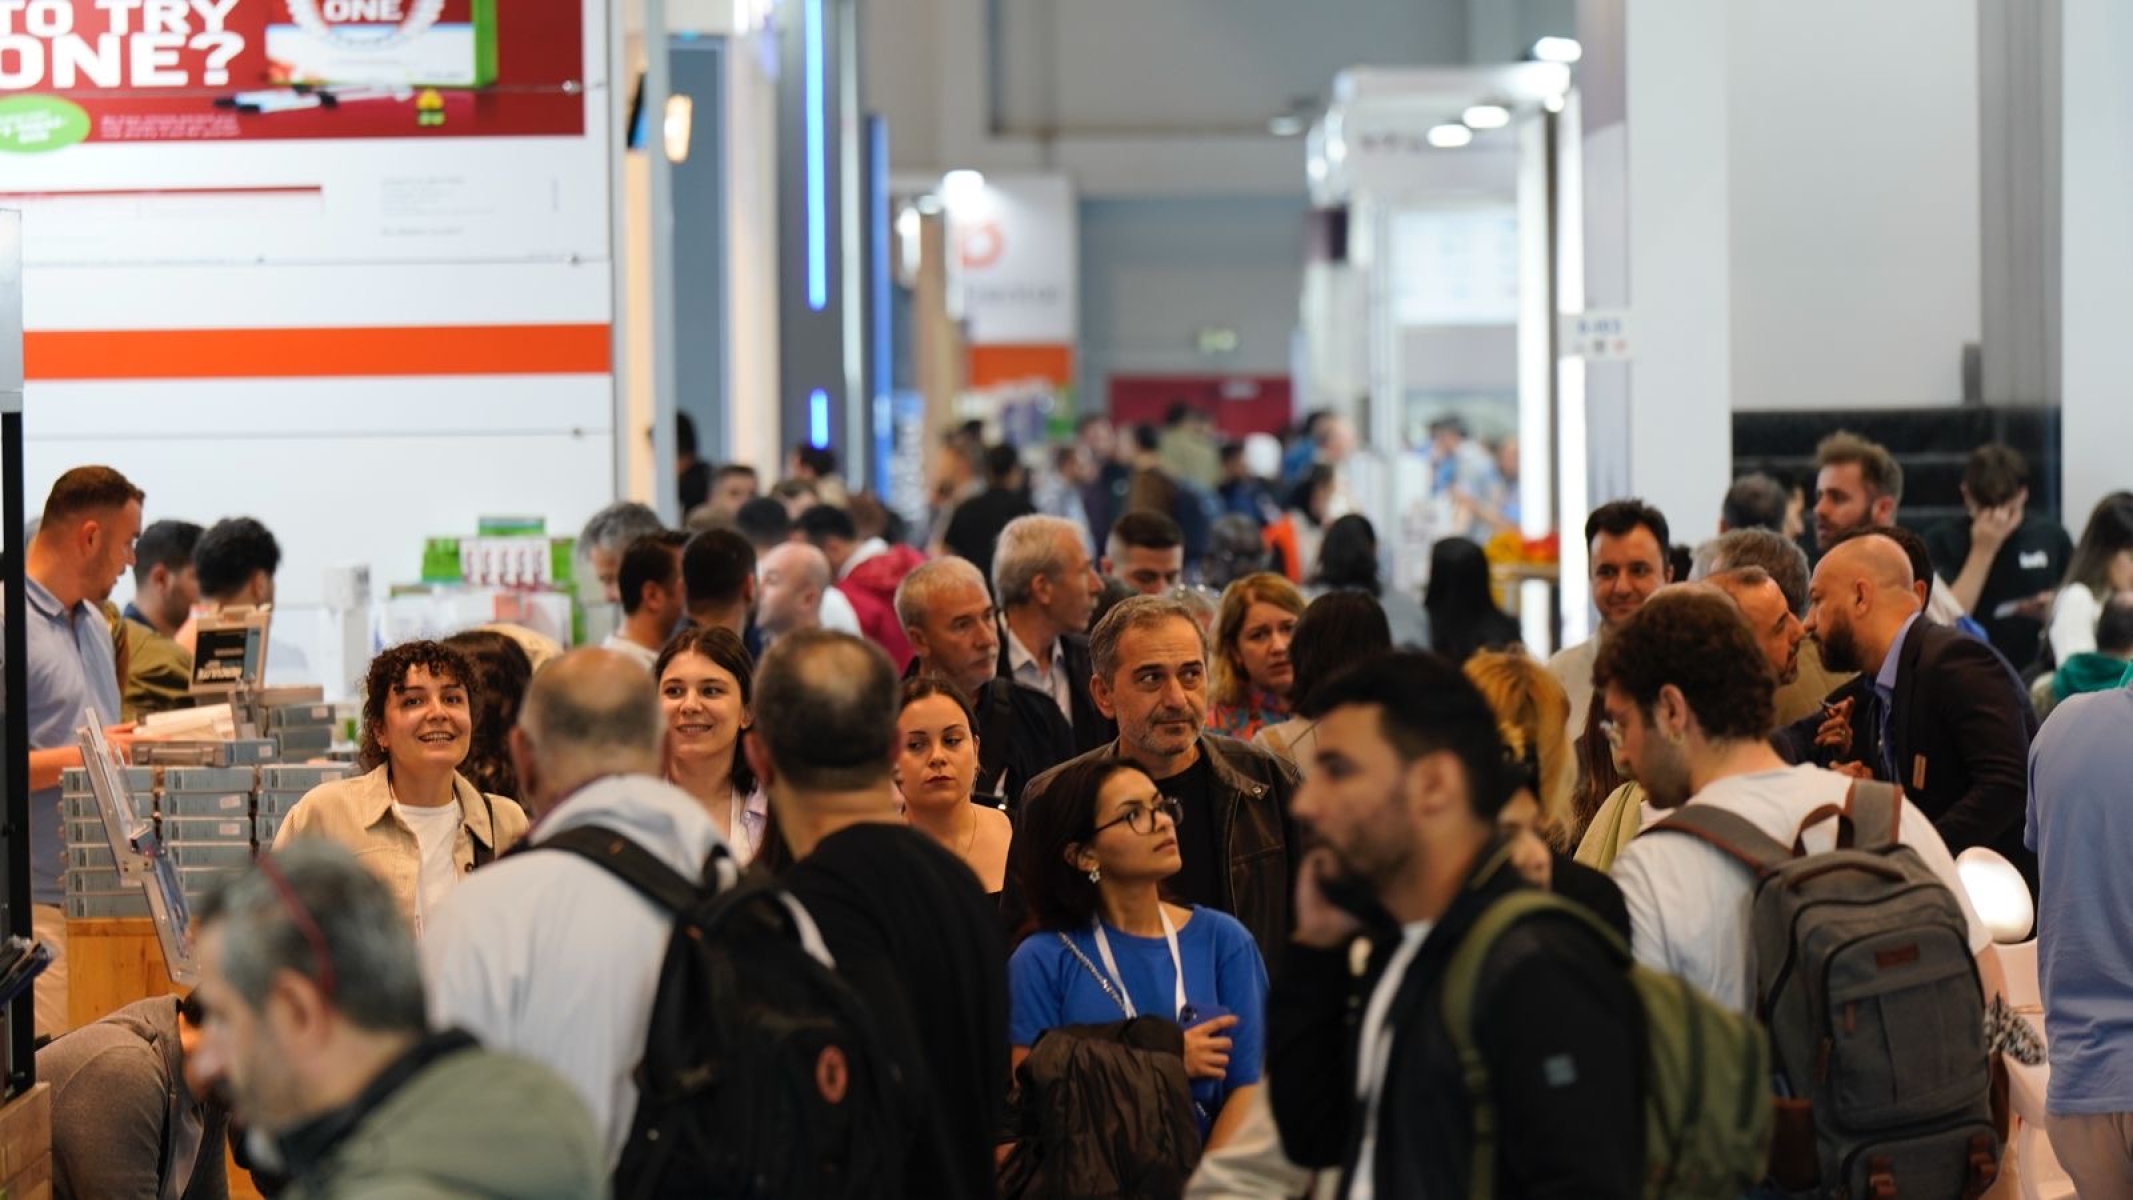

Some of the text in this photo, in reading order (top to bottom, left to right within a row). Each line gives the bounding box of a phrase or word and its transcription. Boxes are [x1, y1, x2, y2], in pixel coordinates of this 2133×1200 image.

[0, 0, 240, 37] TO TRY
[323, 0, 404, 22] ONE
[0, 32, 245, 89] ONE?
